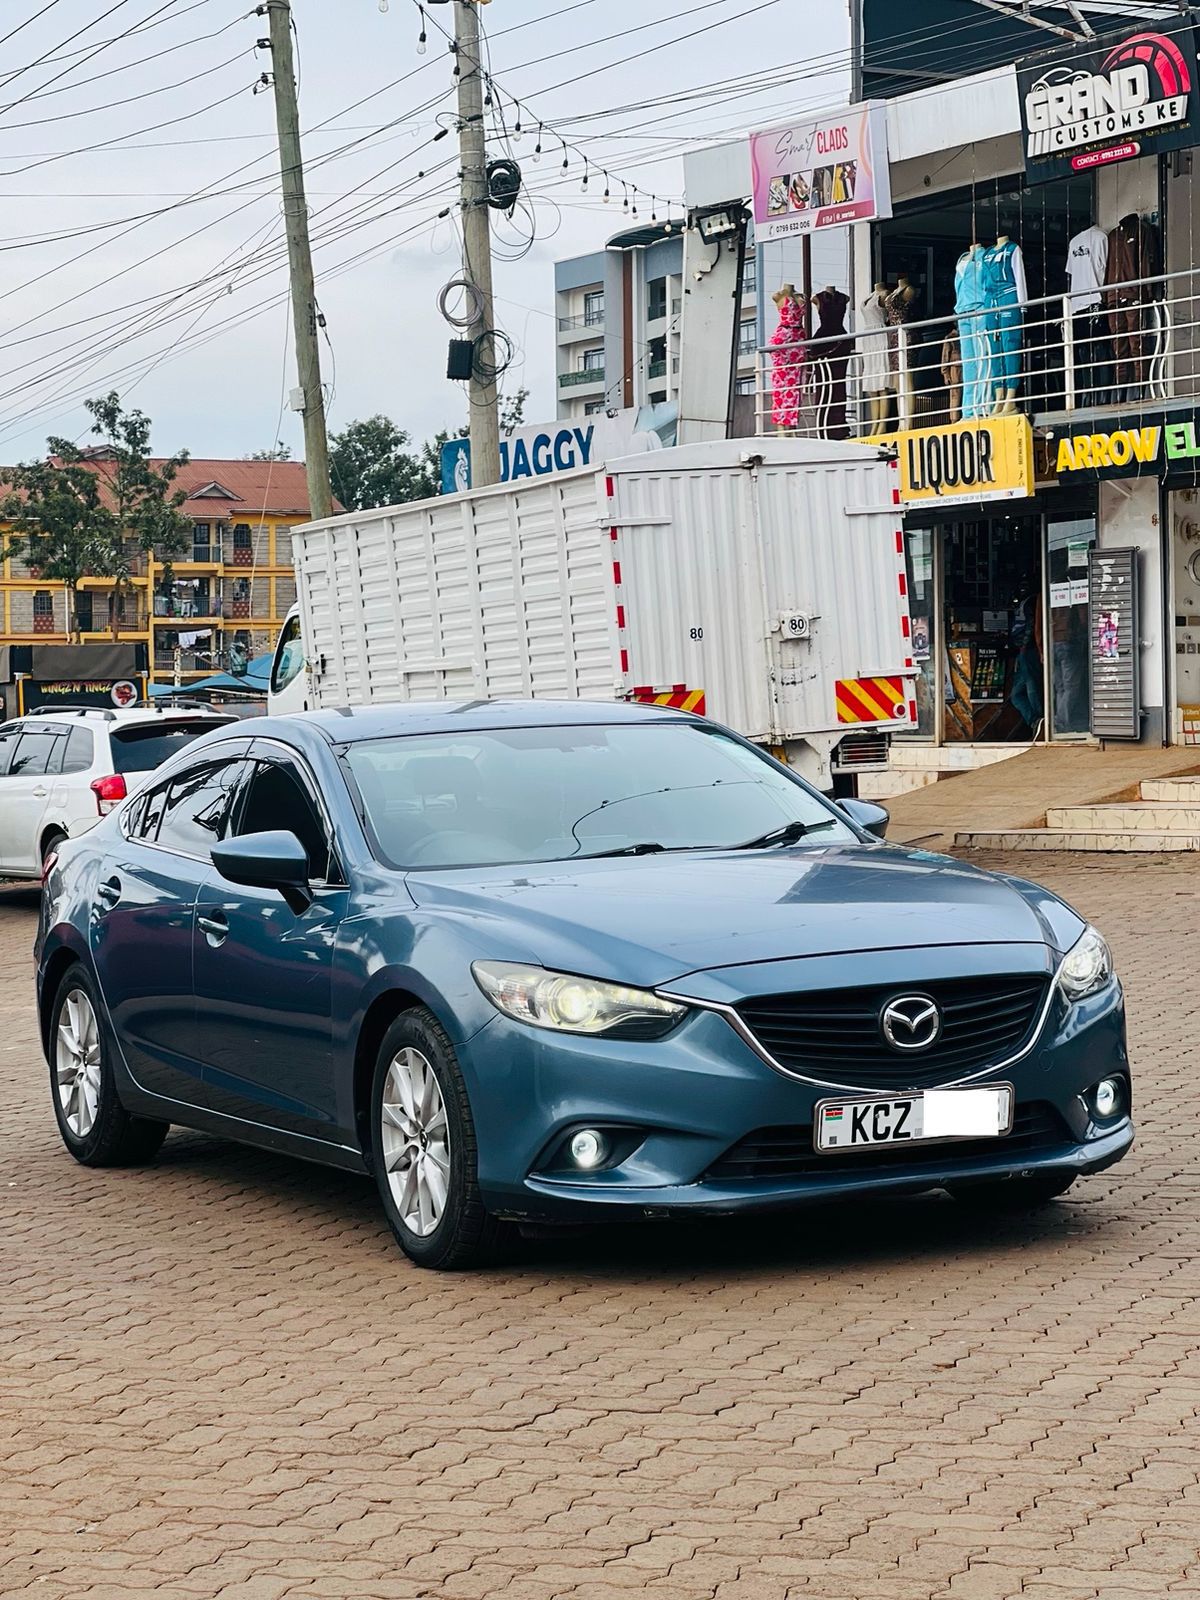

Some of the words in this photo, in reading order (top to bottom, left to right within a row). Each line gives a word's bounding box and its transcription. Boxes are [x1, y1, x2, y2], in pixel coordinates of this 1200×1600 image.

[1025, 64, 1149, 133] GRAND
[1055, 110, 1145, 144] CUSTOMS
[1156, 101, 1177, 119] KE
[775, 123, 818, 168] Smart
[816, 126, 848, 154] CLADS
[1076, 155, 1098, 166] CONTACT
[500, 425, 594, 482] JAGGY
[907, 429, 996, 496] LIQUOR
[1056, 425, 1161, 473] ARROW
[690, 628, 704, 639] 80
[790, 618, 804, 630] 80
